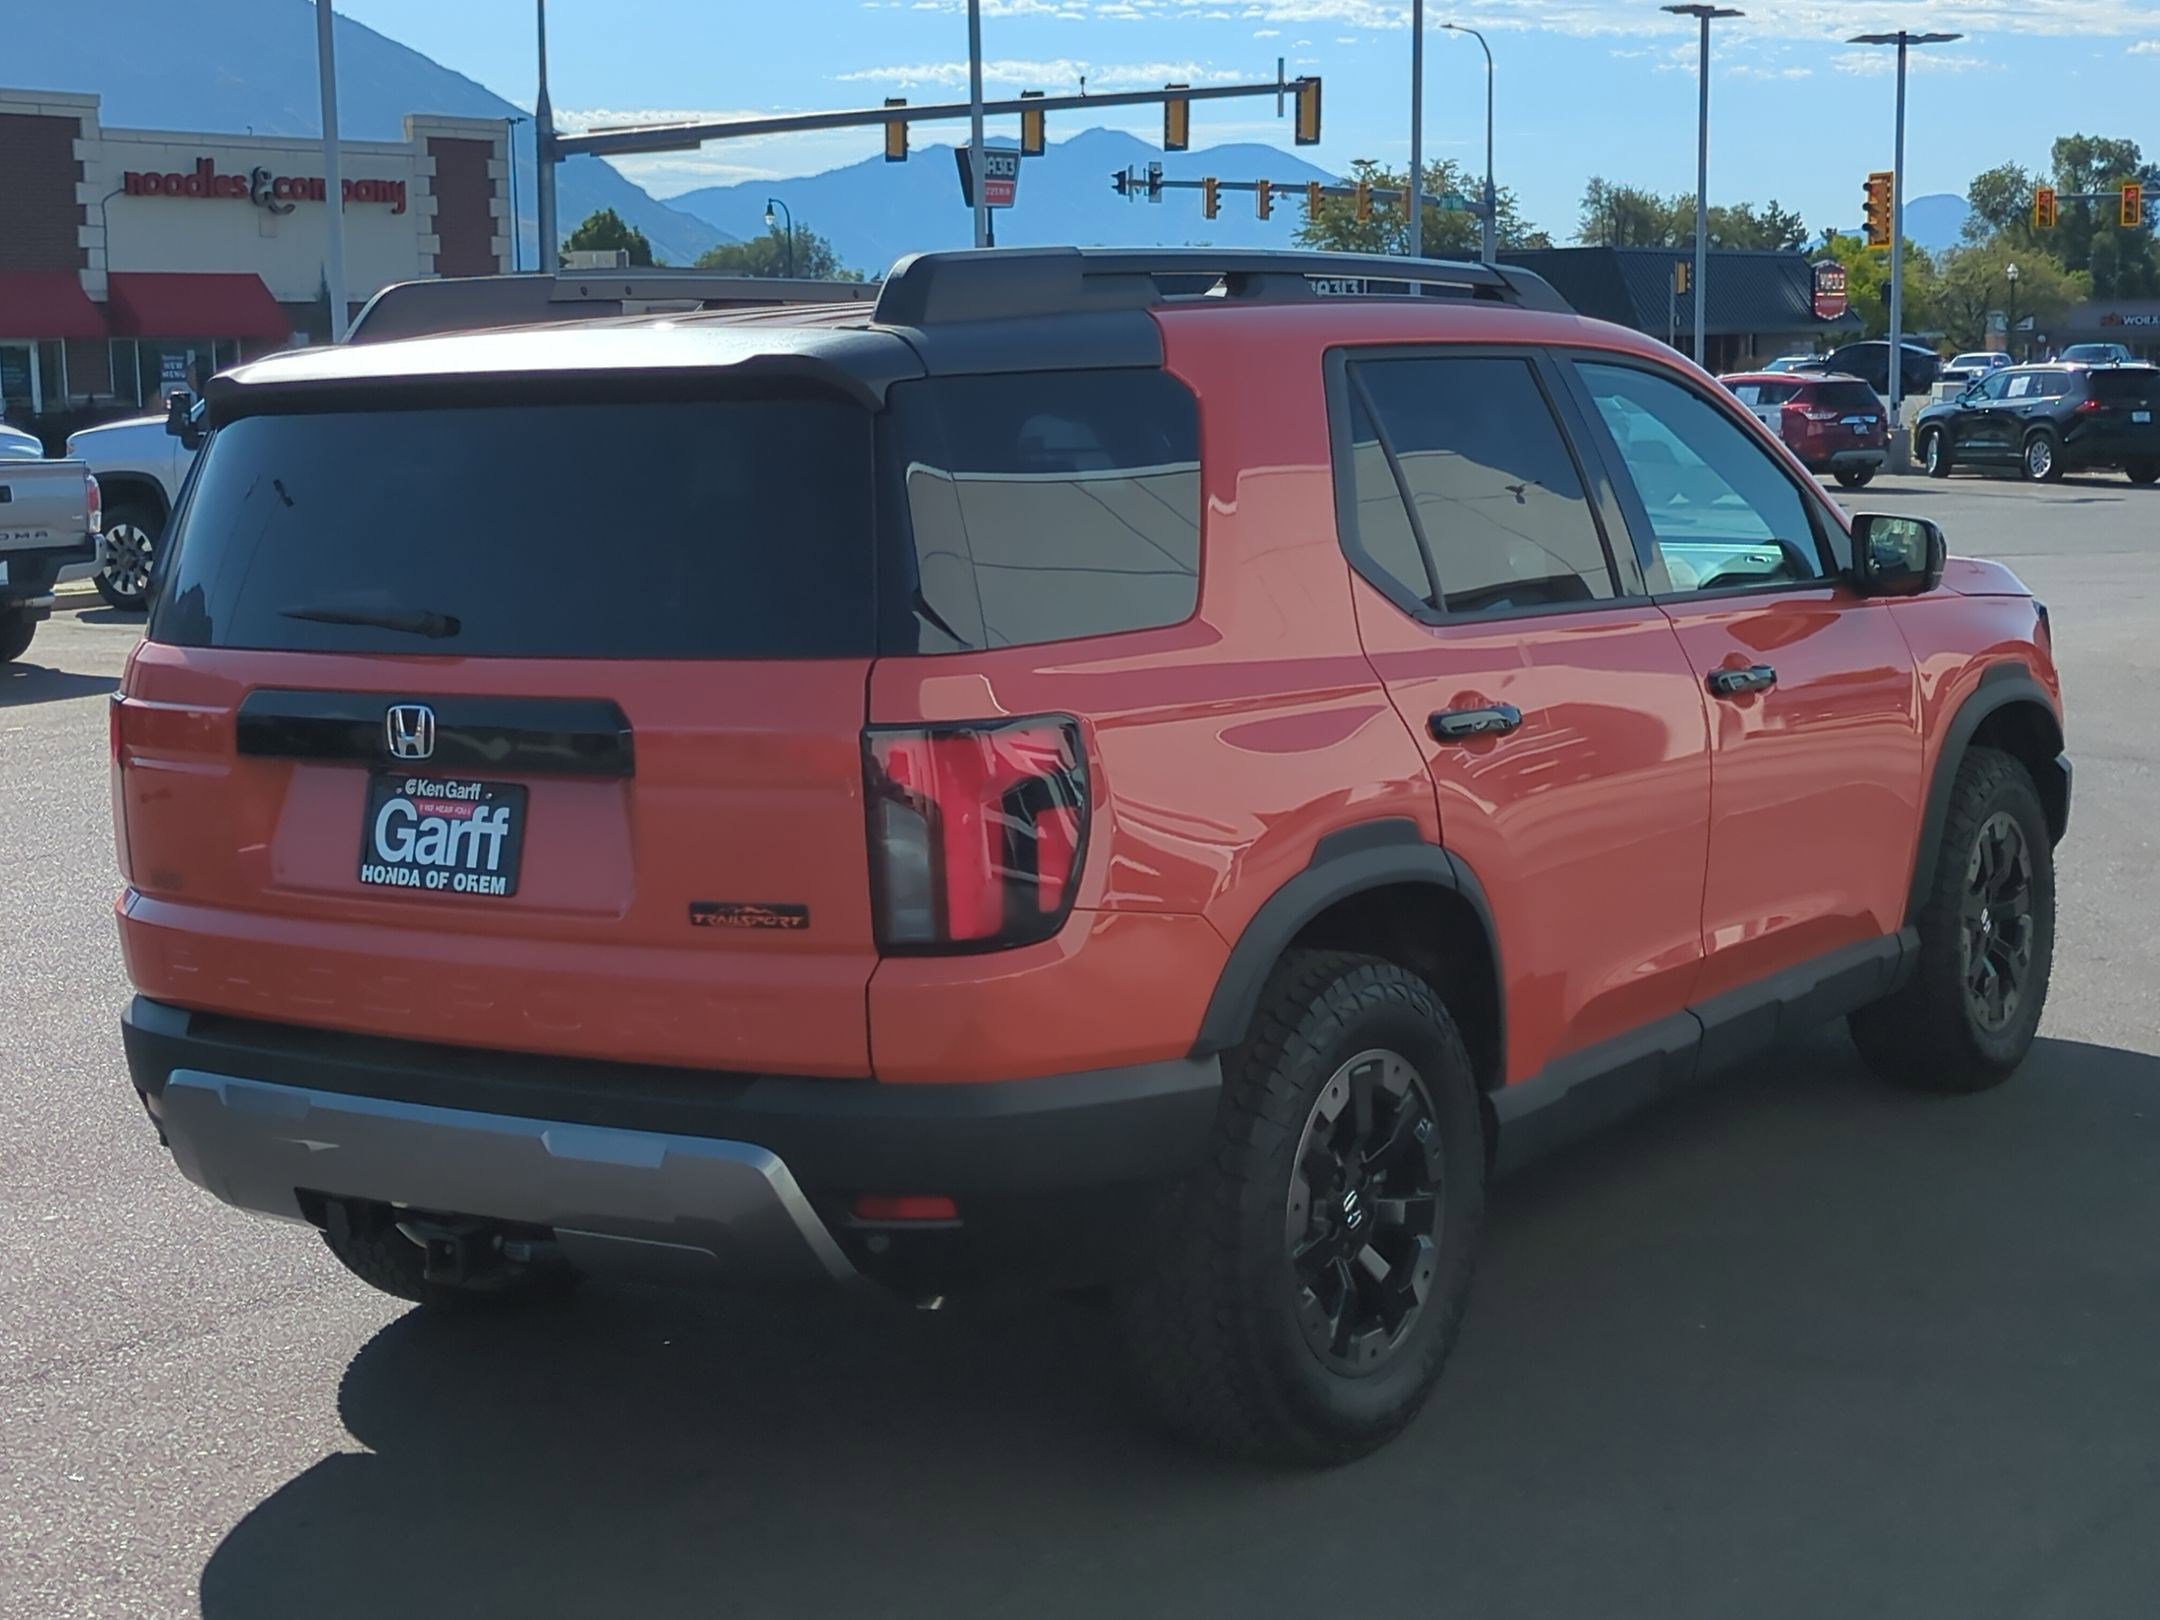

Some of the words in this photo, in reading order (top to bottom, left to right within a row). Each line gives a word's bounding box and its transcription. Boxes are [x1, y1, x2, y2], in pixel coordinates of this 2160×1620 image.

[124, 157, 248, 198] noodles
[417, 779, 445, 798] Ken
[445, 781, 482, 800] Garff
[375, 798, 510, 871] Garff
[361, 864, 421, 888] HONDA
[425, 870, 450, 889] OF
[453, 873, 507, 896] OREM
[693, 913, 802, 928] TRAILSPORT
